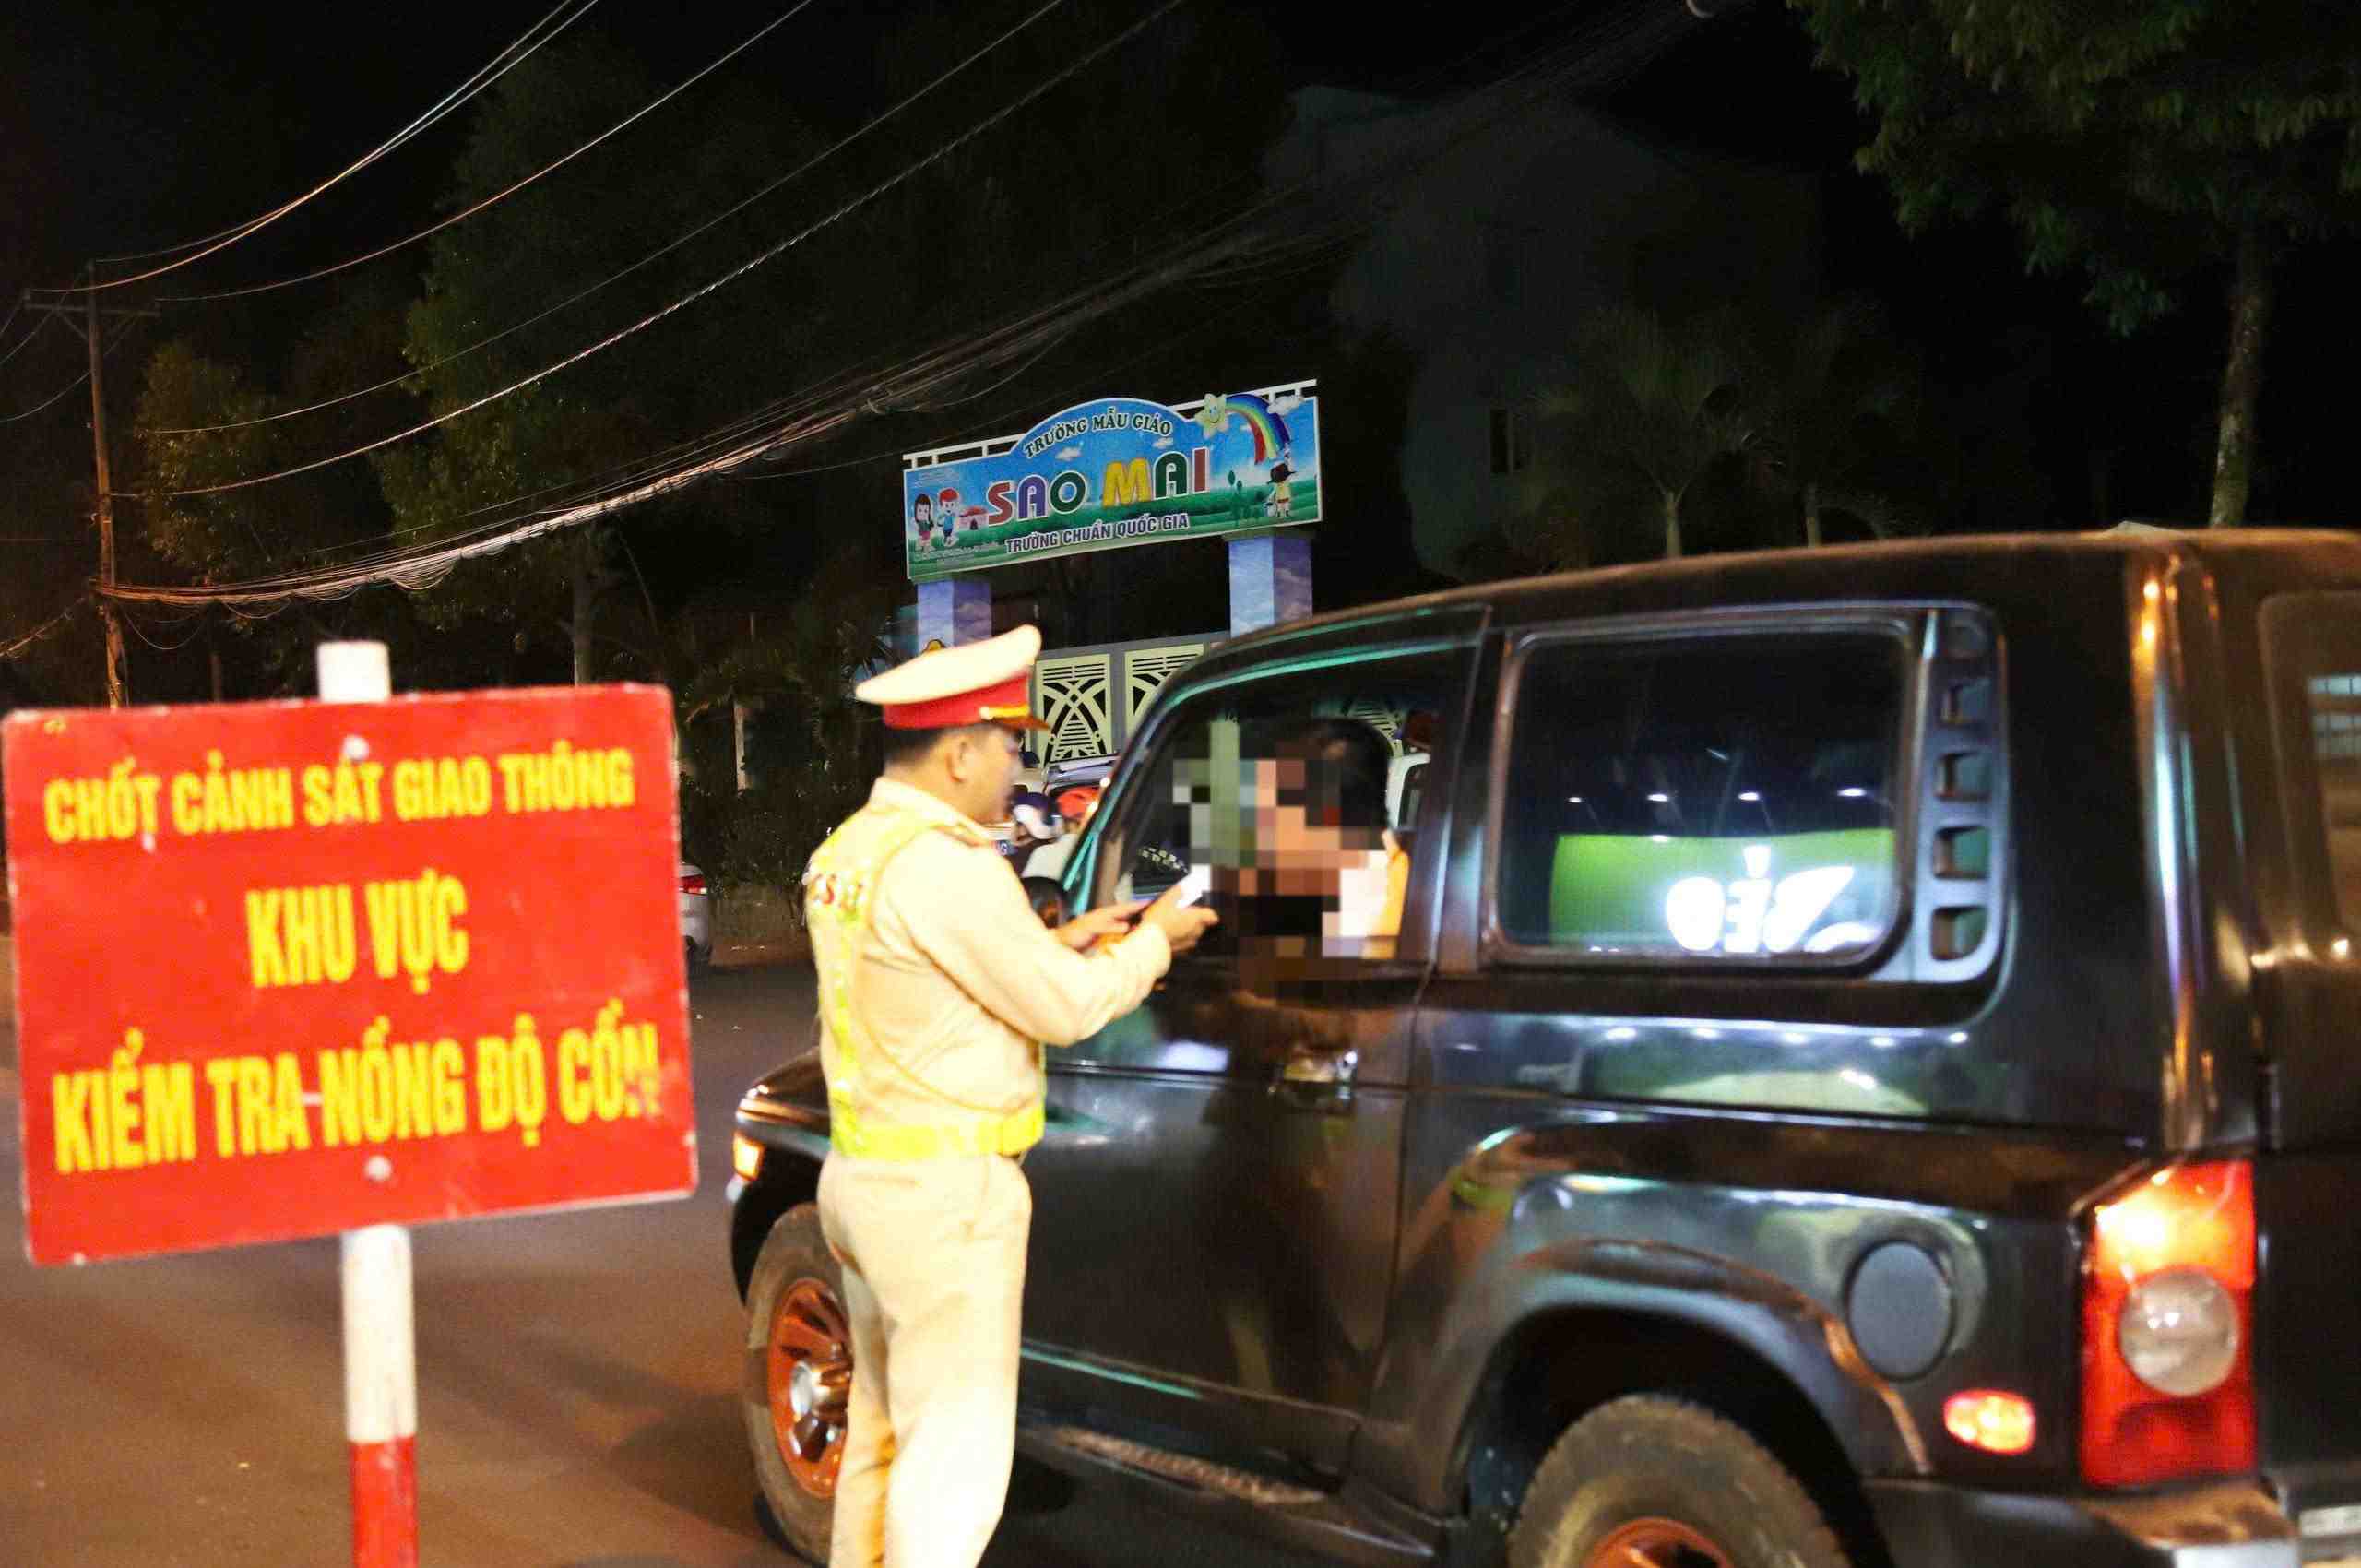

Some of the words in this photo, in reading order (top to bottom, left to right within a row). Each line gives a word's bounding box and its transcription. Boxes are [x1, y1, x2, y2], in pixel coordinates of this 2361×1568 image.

[1024, 418, 1088, 458] TRƯỜNG
[1092, 406, 1127, 431] MẪU
[1133, 412, 1172, 436] GIÁO
[987, 470, 1088, 527] SAO
[1102, 446, 1210, 508] MAI
[1004, 531, 1060, 553] TRƯỜNG
[1115, 513, 1157, 538] QUỐC
[1162, 513, 1190, 530] GIA
[44, 755, 161, 843] CHỐT
[172, 749, 295, 835] CẢNH
[303, 743, 384, 826] SÁT
[393, 755, 492, 821] GIAO
[498, 738, 635, 814] THÔNG
[246, 883, 357, 989] KHU
[365, 867, 469, 995] VỰC
[53, 1027, 196, 1175] KIỂM
[206, 1051, 312, 1159] TRA
[476, 1012, 547, 1148] ĐỘ
